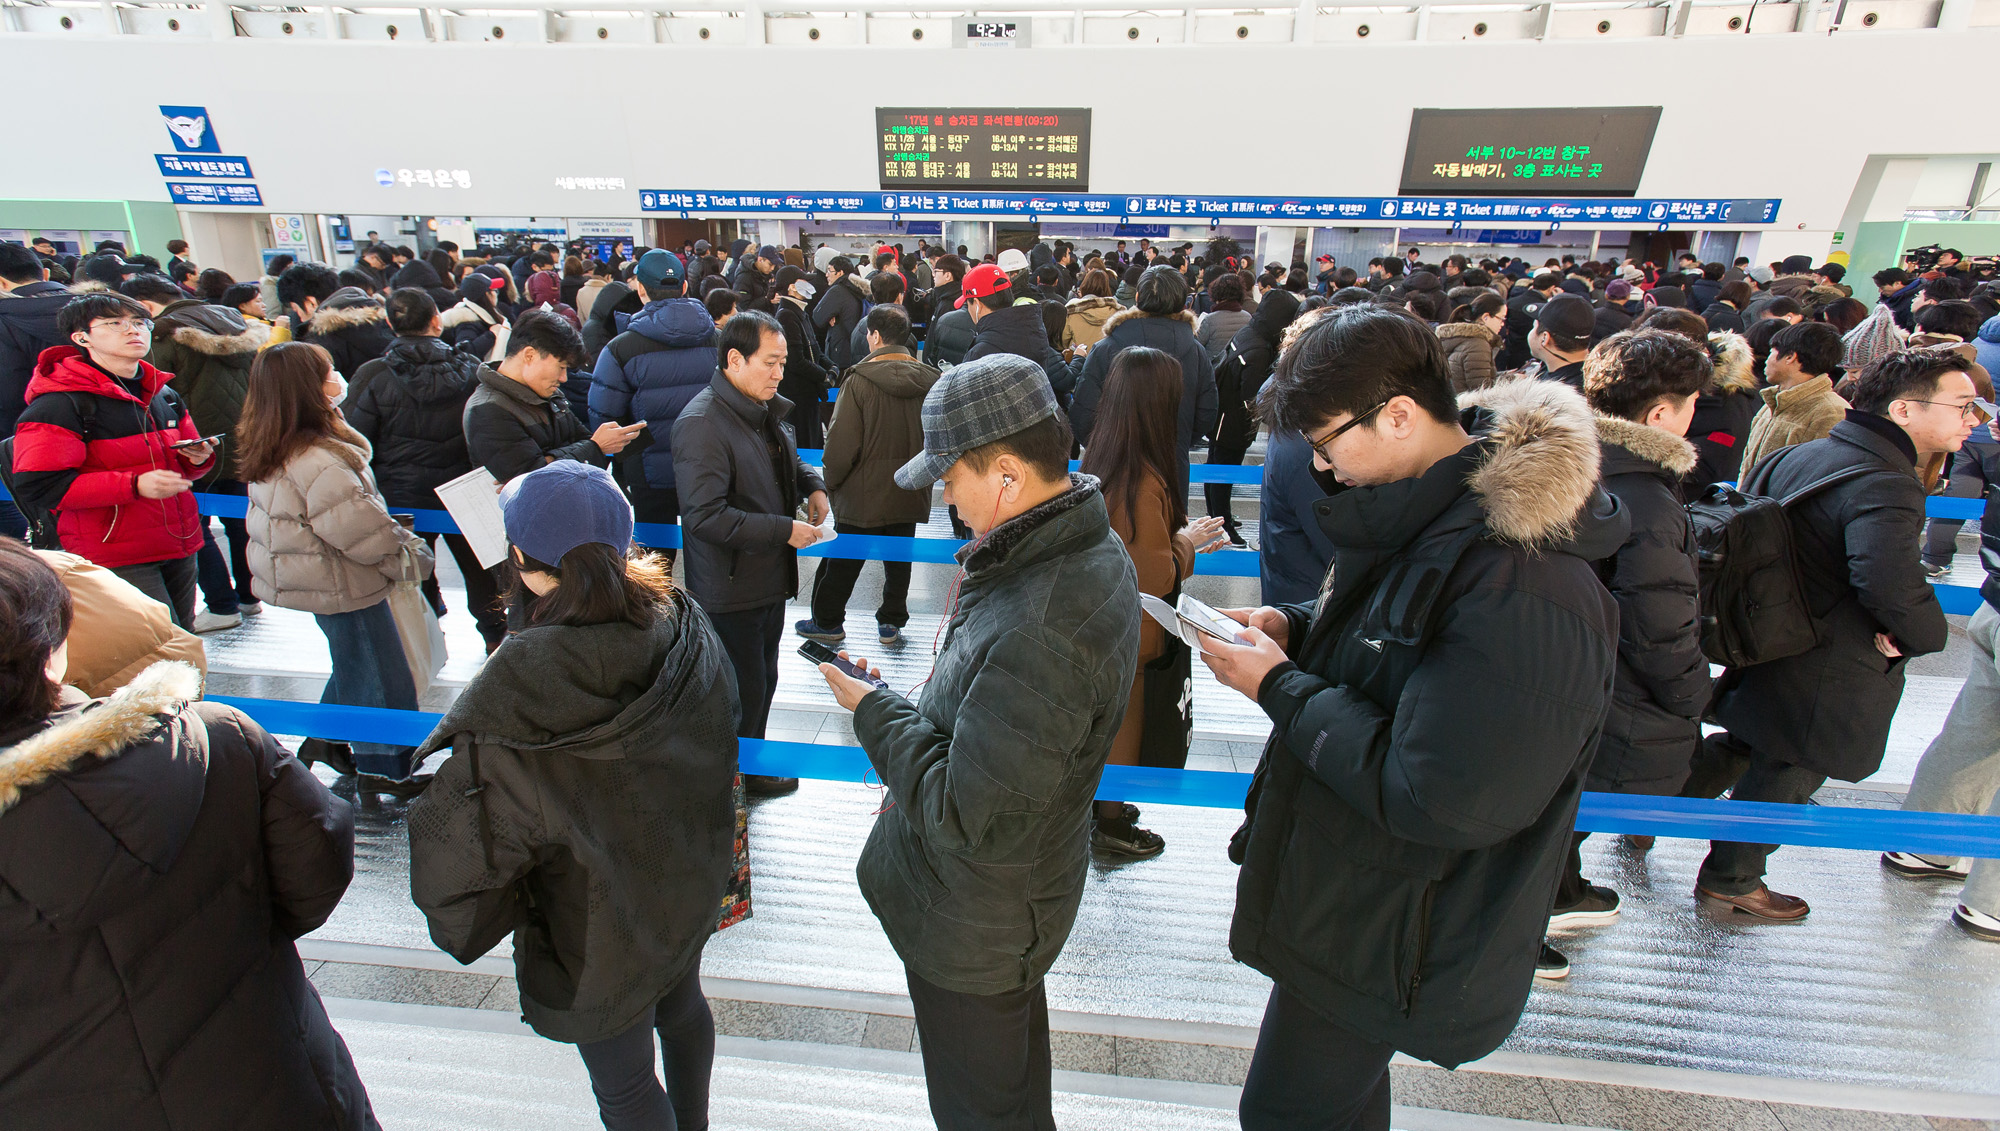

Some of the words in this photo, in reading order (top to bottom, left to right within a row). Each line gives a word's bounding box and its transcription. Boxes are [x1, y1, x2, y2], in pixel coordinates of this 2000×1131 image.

[976, 23, 1006, 37] 9:27
[933, 115, 943, 126] 설
[949, 115, 978, 126] 승차권
[892, 126, 929, 135] 하행승차권
[922, 135, 937, 144] 서울
[948, 135, 970, 144] 동대구
[1010, 135, 1026, 144] 이후
[1047, 135, 1078, 144] 좌석매진
[884, 143, 897, 151] KTX
[922, 143, 937, 152] 서울
[948, 143, 962, 152] 부산
[1047, 144, 1078, 153] 좌석매진
[1465, 146, 1494, 161] 서부
[1499, 146, 1557, 161] 10~12번
[1561, 146, 1591, 161] 창구
[893, 152, 930, 161] 상행승차권
[922, 162, 945, 171] 동대구
[955, 162, 971, 171] 서울
[1432, 163, 1506, 179] 자동발매기,
[1513, 164, 1536, 179] 3층
[1540, 164, 1583, 178] 표사는
[1588, 164, 1603, 179] 곳
[397, 168, 472, 189] 우리은행
[922, 170, 945, 178] 동대구
[955, 170, 971, 178] 서울
[658, 193, 694, 207] 표사는
[696, 194, 707, 208] 곳
[710, 195, 737, 207] Ticket
[899, 196, 934, 210] 표사는
[937, 196, 949, 210] 곳
[952, 198, 980, 209] Ticket
[1145, 198, 1182, 213] 표사는
[1184, 199, 1197, 214] 곳
[1200, 200, 1229, 212] Ticket
[1401, 201, 1440, 216] 표사는
[1443, 202, 1457, 217] 곳
[1460, 204, 1491, 215] Ticket
[1669, 203, 1703, 215] 표사는
[1705, 203, 1717, 215] 곳
